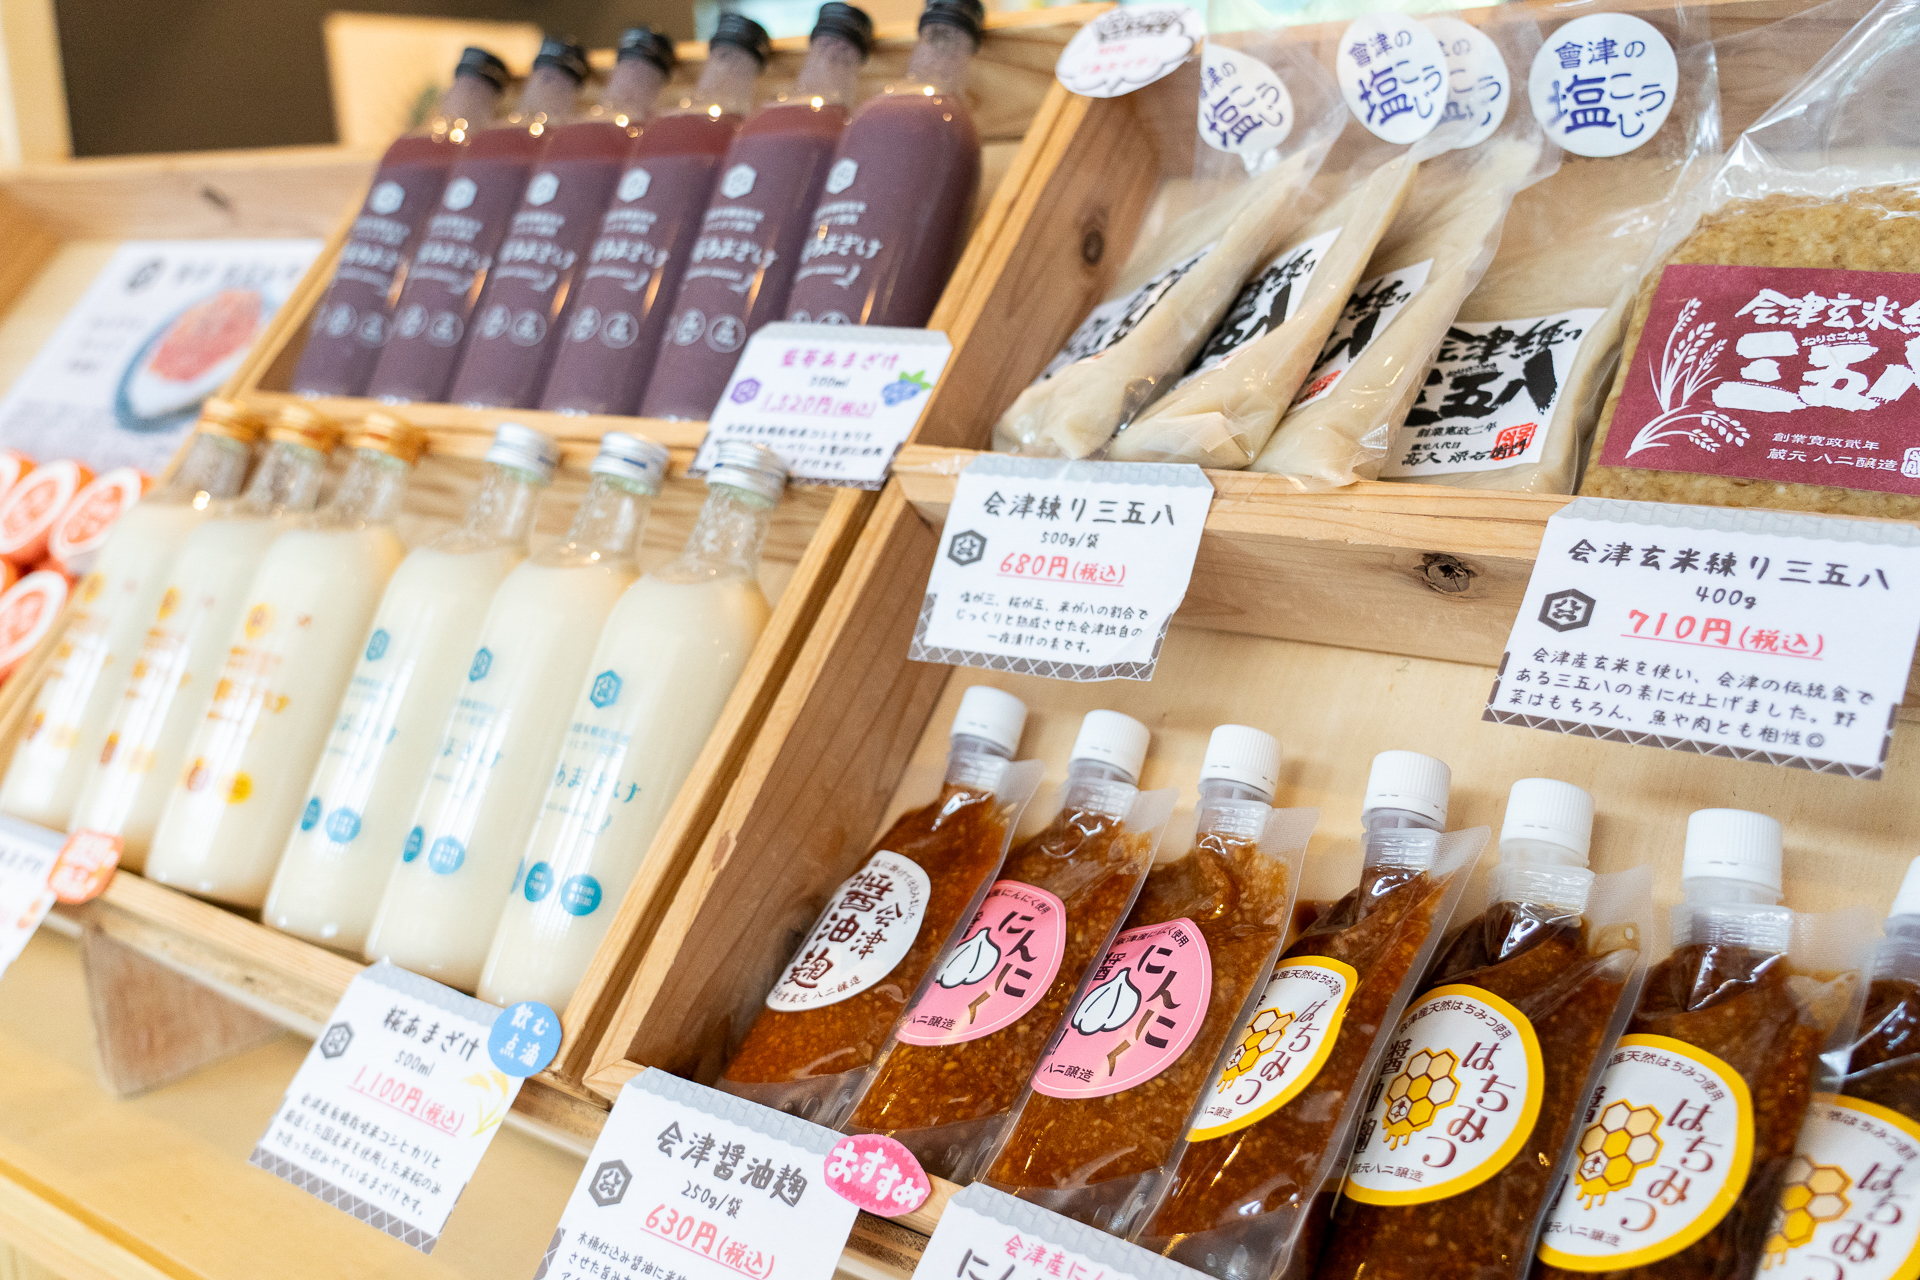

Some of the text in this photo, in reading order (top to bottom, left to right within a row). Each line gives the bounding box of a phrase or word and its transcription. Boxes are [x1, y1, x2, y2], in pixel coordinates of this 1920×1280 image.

[1555, 37, 1646, 69] 會津の
[1204, 95, 1263, 148] 塩
[1359, 67, 1414, 126] 塩
[1549, 73, 1617, 134] 塩
[983, 491, 1175, 525] 会津練り三五八
[1041, 531, 1100, 549] 500g/袋
[1568, 538, 1892, 590] 会津玄米練り三五八
[999, 552, 1126, 584] 680円(税込)
[1695, 586, 1757, 610] 400g
[1628, 609, 1824, 657] 710円(税込)
[1515, 667, 1858, 728] ある三五八の素に仕上げました。野
[850, 902, 902, 960] 会津
[968, 911, 1037, 1024] にんにく
[509, 1003, 549, 1036] 飲む
[1106, 944, 1181, 1077] にんにく
[395, 1049, 436, 1077] 500ml
[500, 1033, 540, 1067] 点滴
[1235, 1000, 1328, 1105] はちみつ
[1607, 1050, 1725, 1102] 産天然はちみつ使用
[1422, 1042, 1516, 1168] はちみつ
[657, 1120, 809, 1207] 会津醤油麹
[827, 1141, 925, 1206] おすすめ
[1620, 1098, 1722, 1232] はちみつ
[681, 1180, 744, 1219] 250g/袋
[645, 1203, 775, 1280] 630円(税込)
